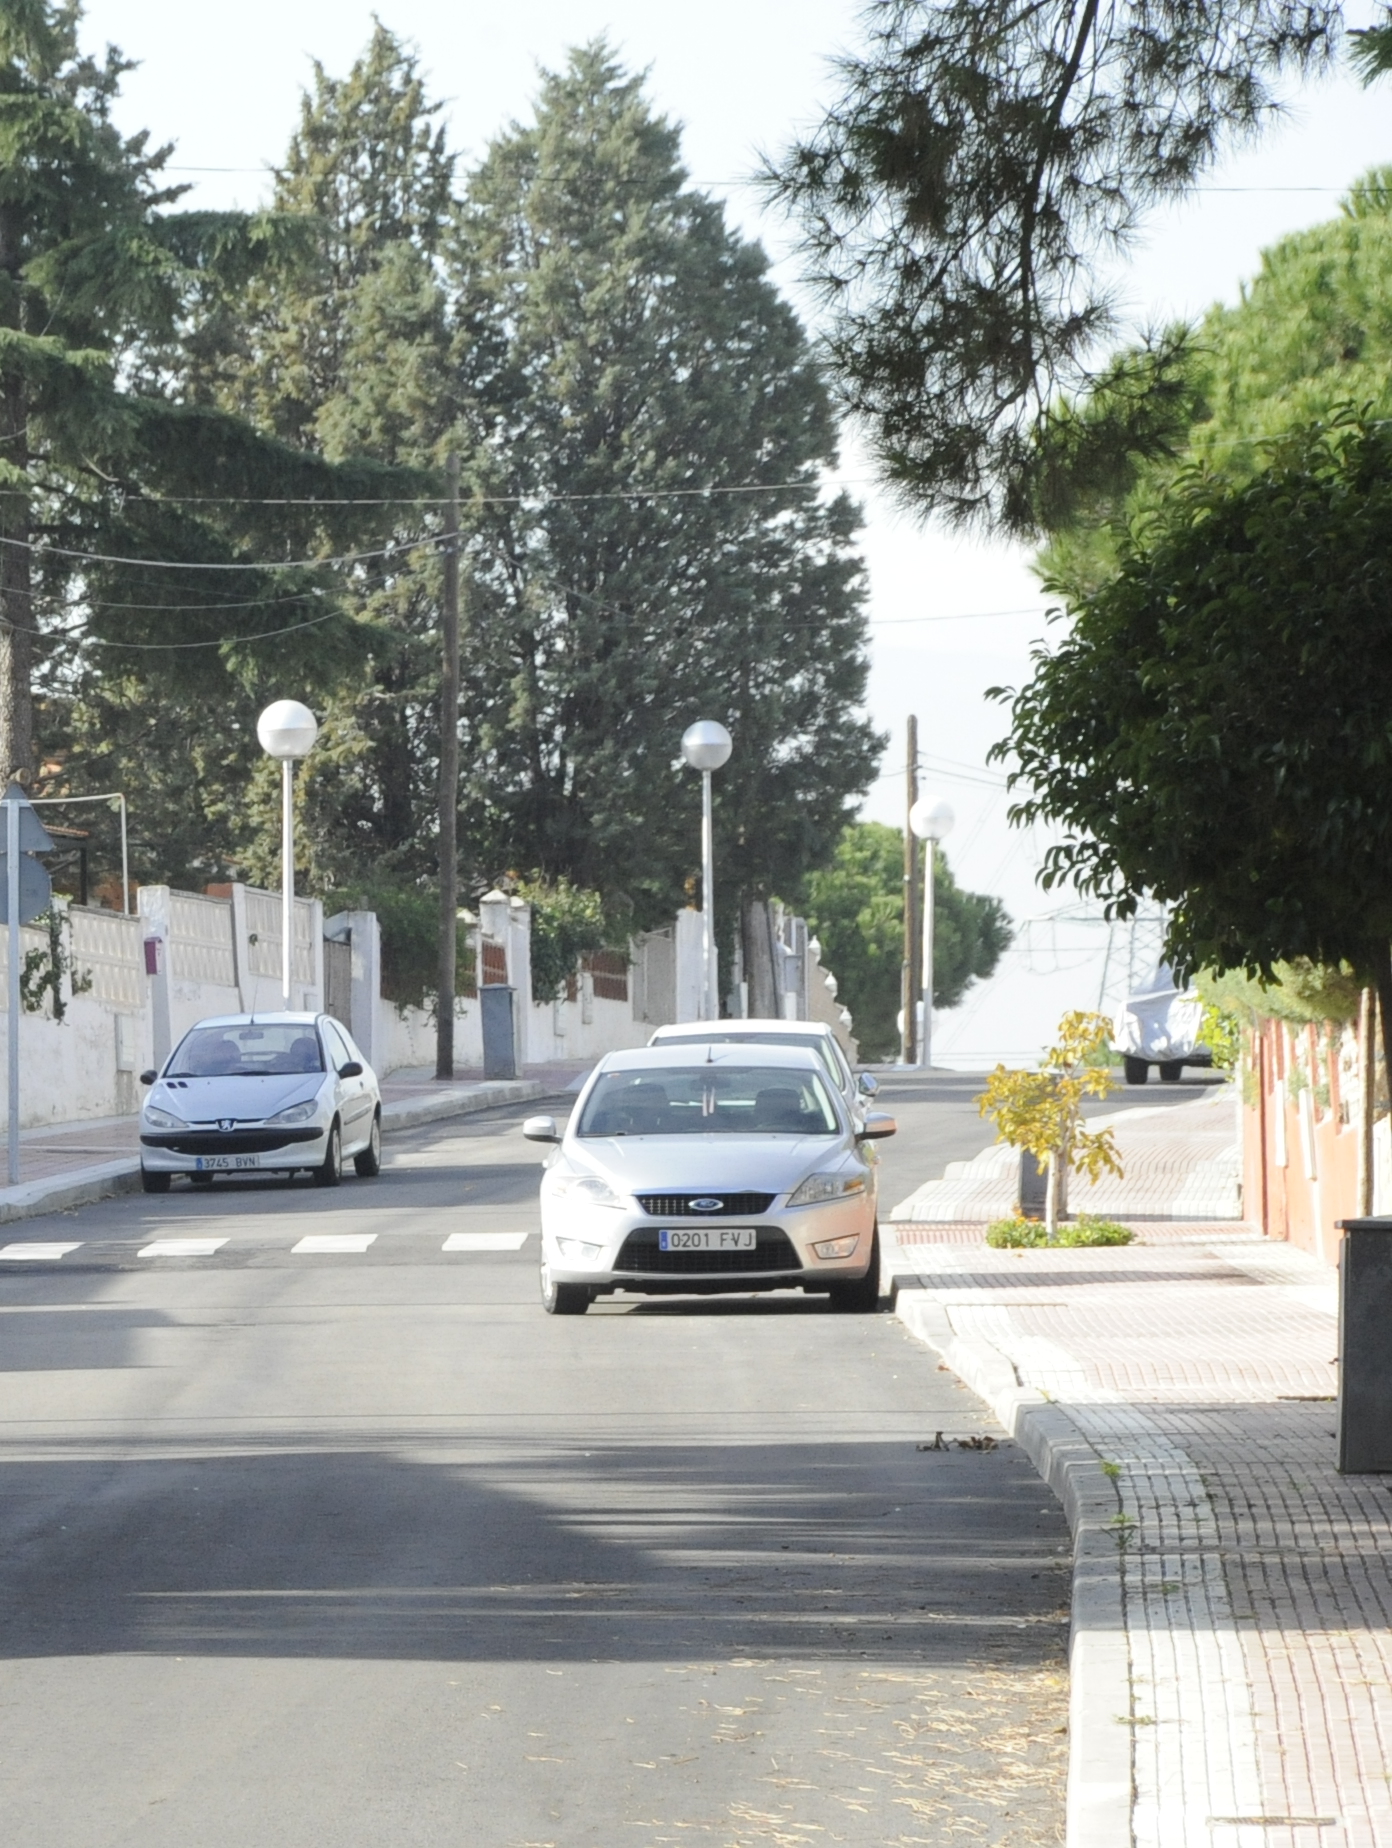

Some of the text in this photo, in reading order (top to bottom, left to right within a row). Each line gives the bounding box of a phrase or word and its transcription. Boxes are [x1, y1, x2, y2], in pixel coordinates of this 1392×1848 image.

[204, 1157, 256, 1168] 3745 BVN
[671, 1232, 752, 1248] 0201 FVJ
